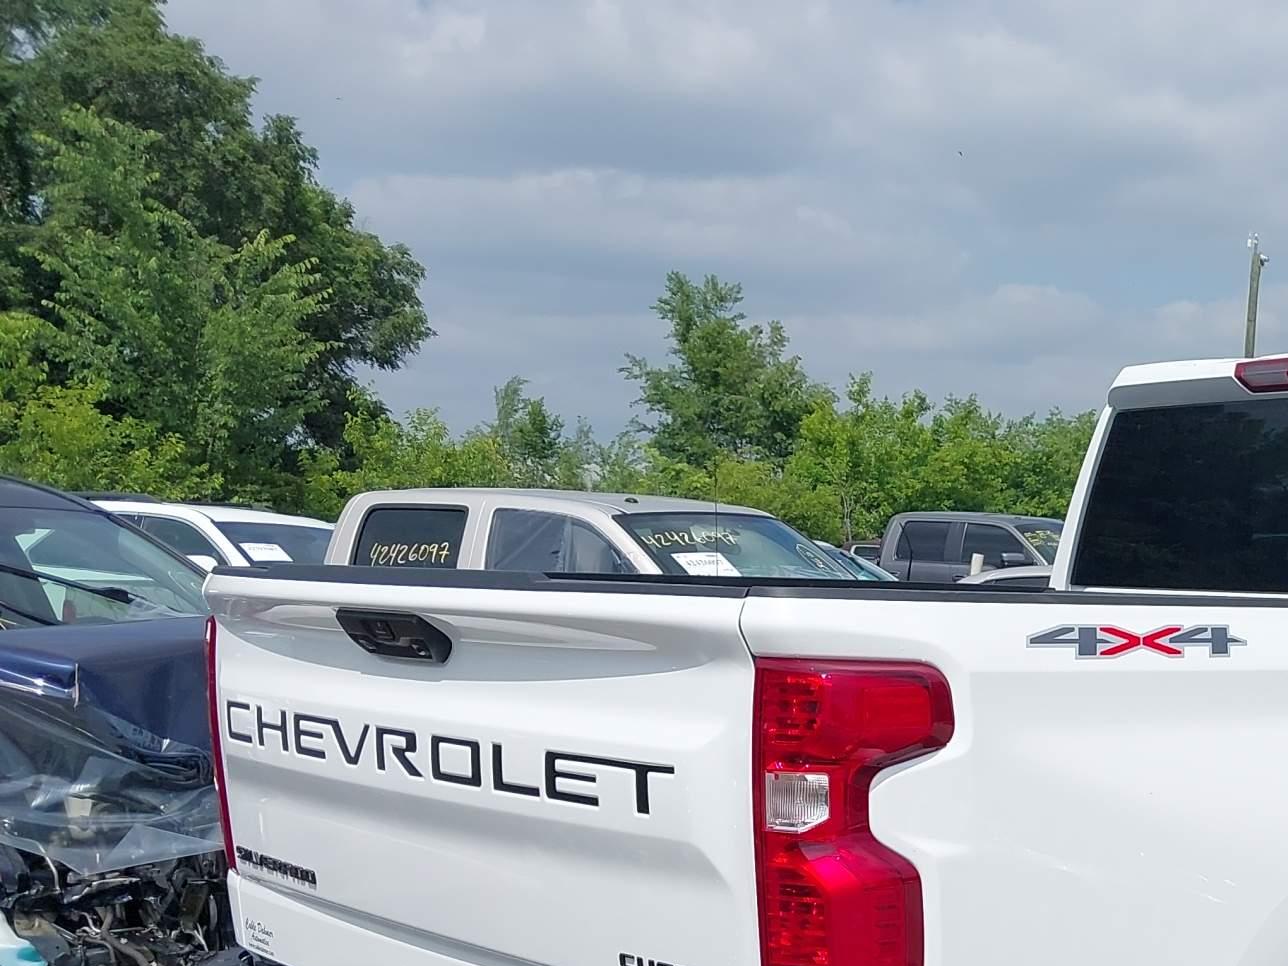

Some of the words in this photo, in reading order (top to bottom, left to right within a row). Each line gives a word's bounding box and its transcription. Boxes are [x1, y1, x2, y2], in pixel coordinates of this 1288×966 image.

[370, 541, 450, 567] 42426097
[226, 700, 676, 816] CHEVROLET
[235, 845, 317, 886] SILVERADO
